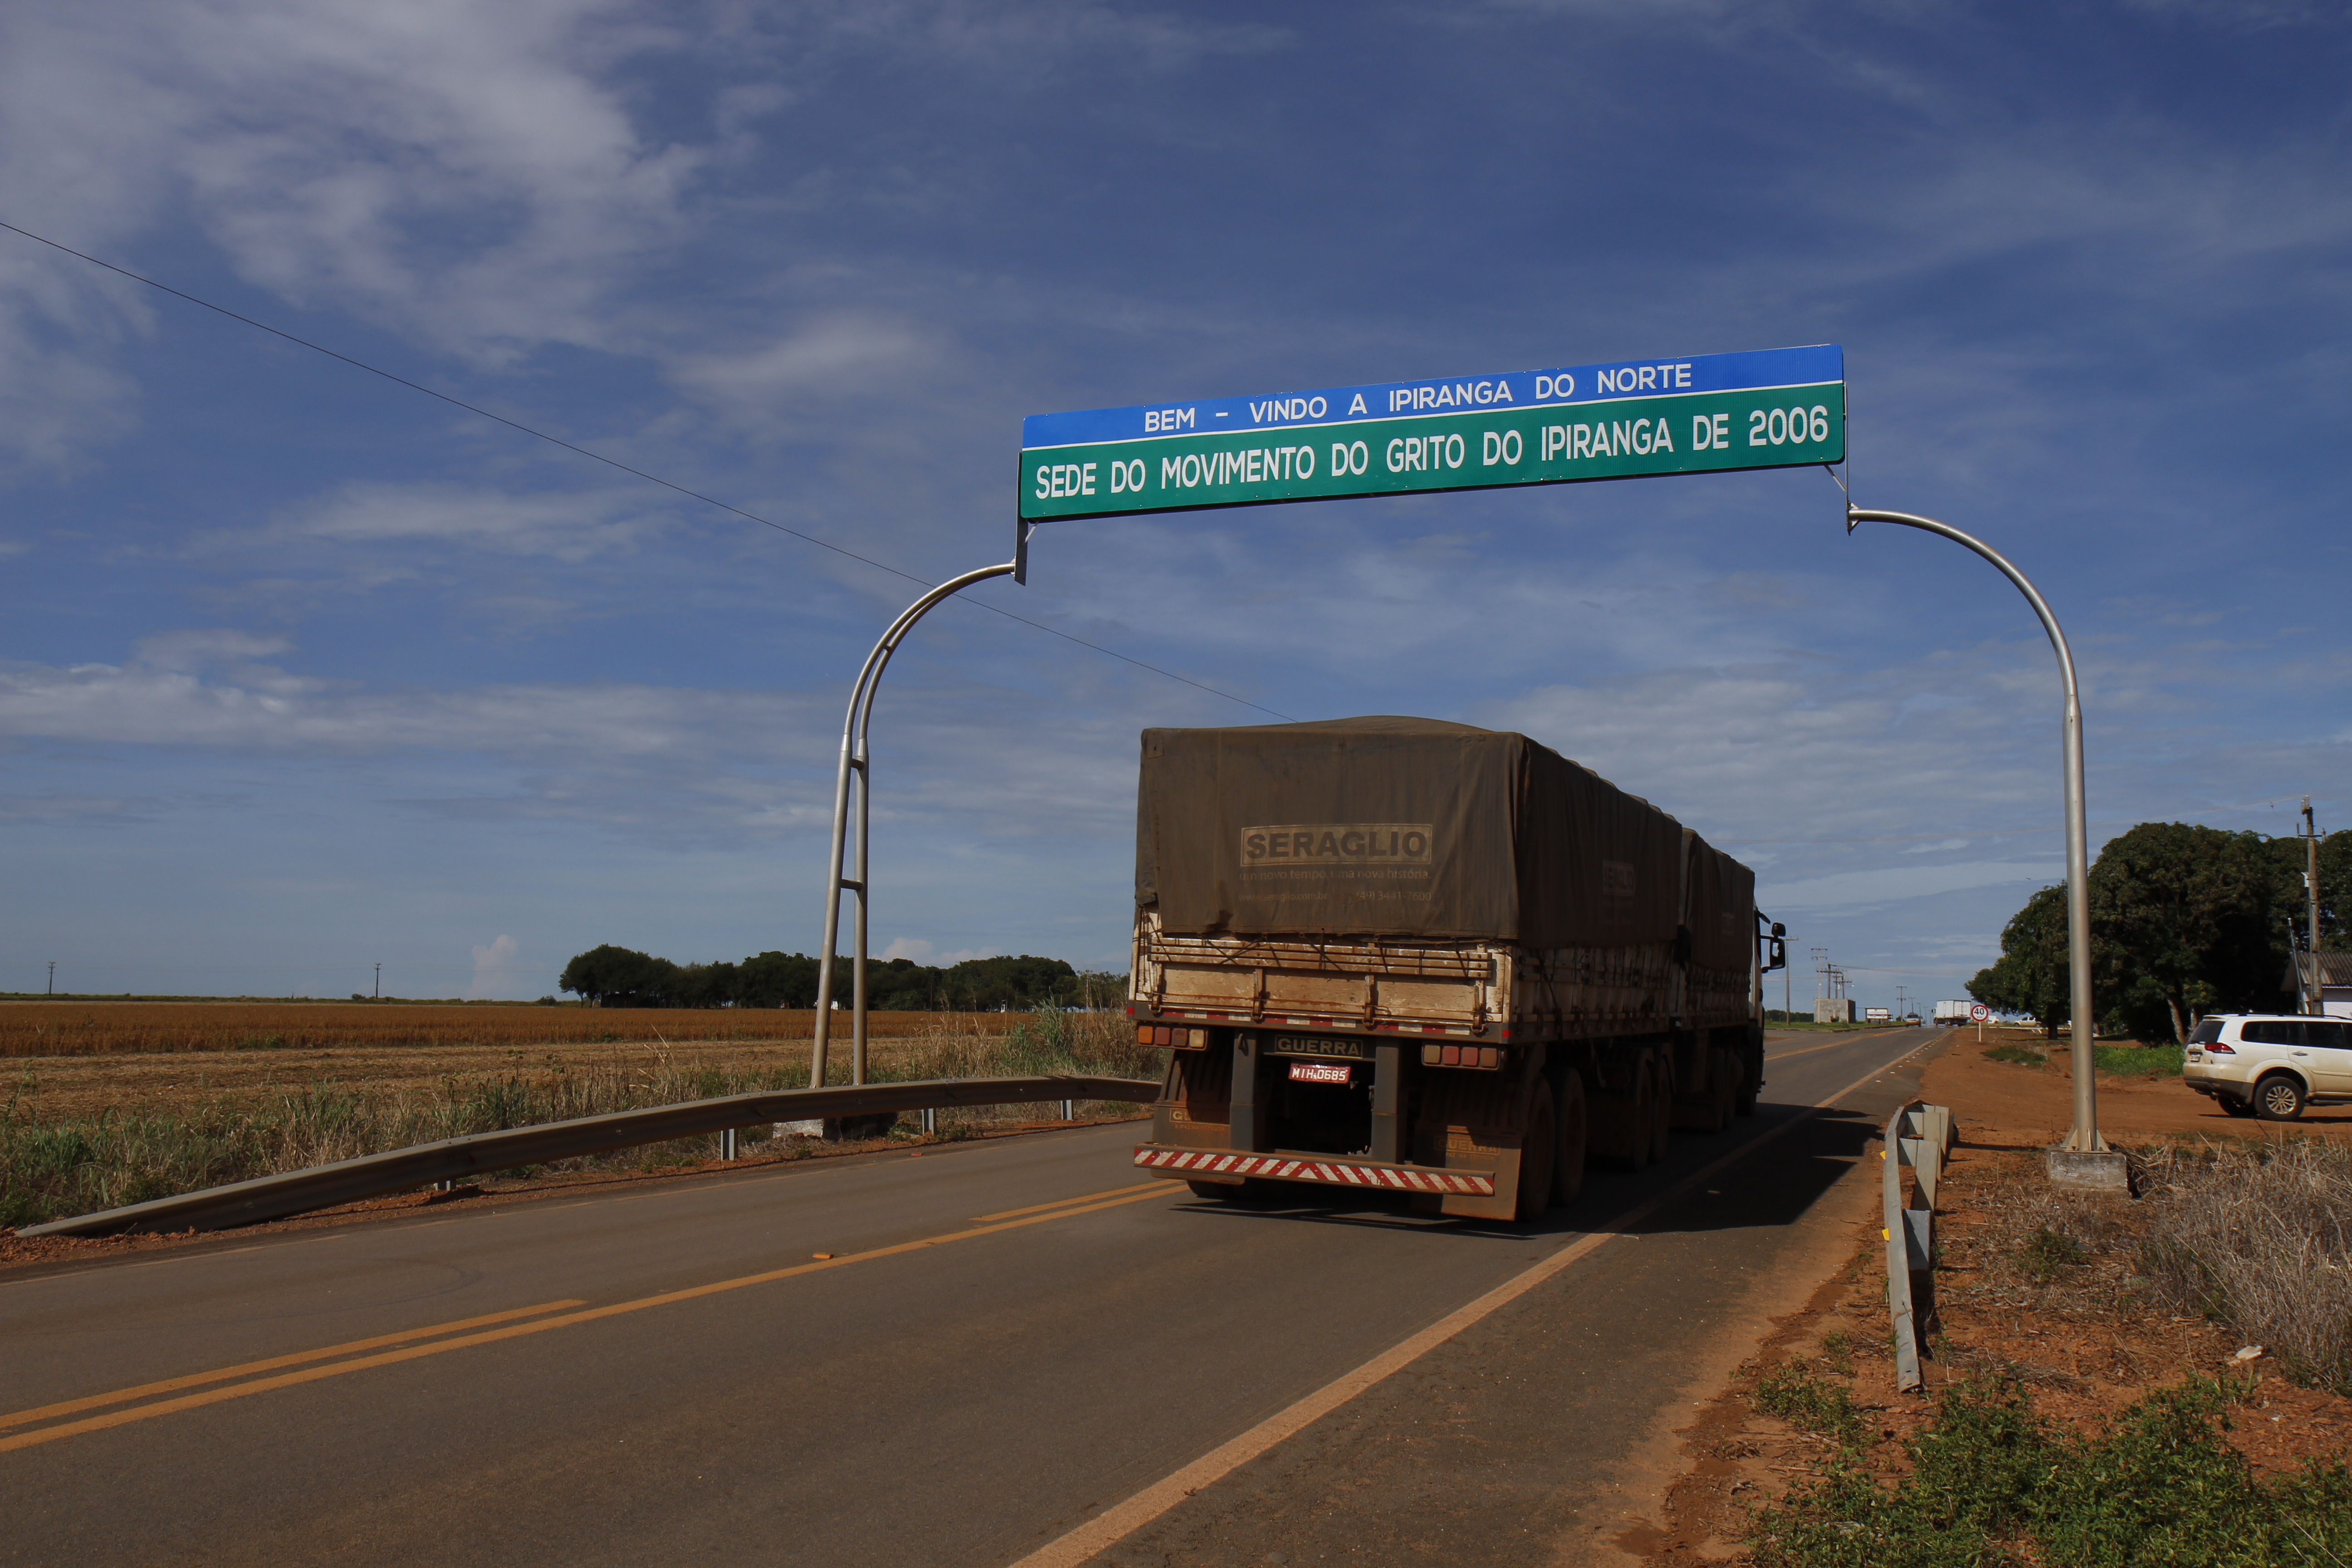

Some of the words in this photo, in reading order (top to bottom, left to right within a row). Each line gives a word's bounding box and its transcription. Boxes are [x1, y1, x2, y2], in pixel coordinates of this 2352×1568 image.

[1145, 407, 1196, 432] BEM
[1249, 396, 1328, 423] VINDO
[1348, 393, 1367, 415] A
[1390, 380, 1513, 412] IPIRANGA
[1536, 374, 1574, 399] DO
[1598, 363, 1692, 393] NORTE
[1035, 463, 1097, 499] SEDE
[1111, 459, 1146, 493] DO
[1161, 446, 1315, 489] MOVIMENTO
[1332, 441, 1368, 476] DO
[1387, 434, 1465, 472] GRITO
[1483, 430, 1522, 466] DO
[1542, 418, 1674, 461] IPIRANGA
[1693, 413, 1729, 451] DE
[1749, 405, 1828, 446] 2006
[1246, 831, 1427, 859] SERAGLIO
[1260, 871, 1287, 880] novo
[1357, 870, 1384, 879] nova
[1387, 867, 1431, 880] história.
[1378, 891, 1431, 901] 3441-7600
[1278, 1038, 1360, 1056] GUERRA
